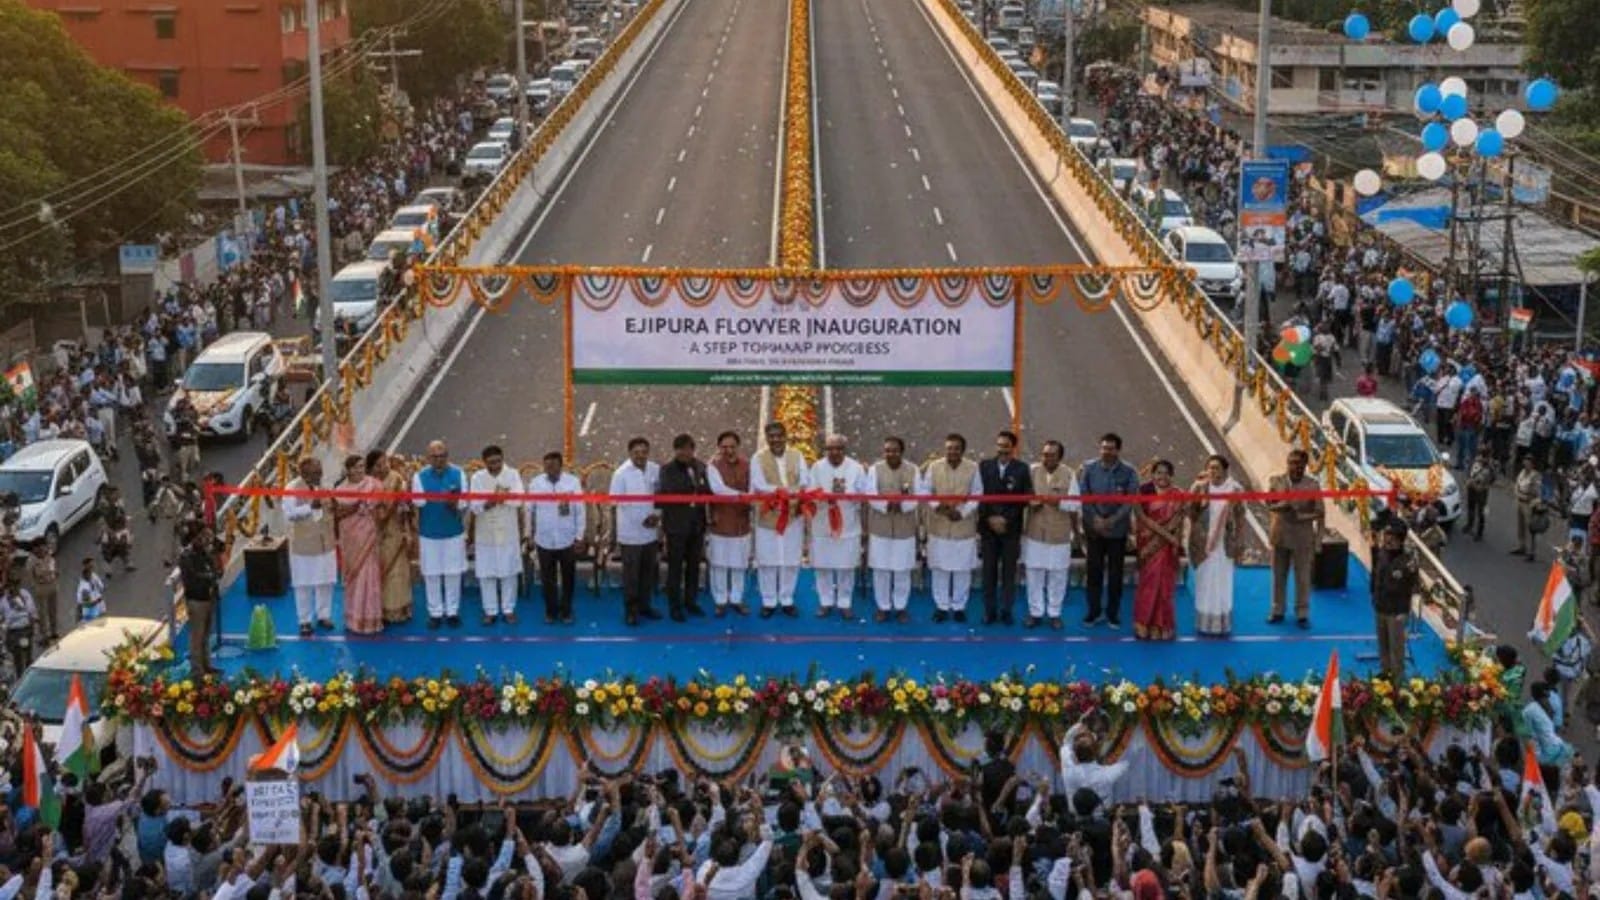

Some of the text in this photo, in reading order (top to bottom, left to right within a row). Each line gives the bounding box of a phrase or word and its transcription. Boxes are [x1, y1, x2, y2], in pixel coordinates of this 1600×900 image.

[625, 317, 709, 334] EJIPURA
[689, 341, 700, 354] A
[703, 341, 737, 354] STEP
